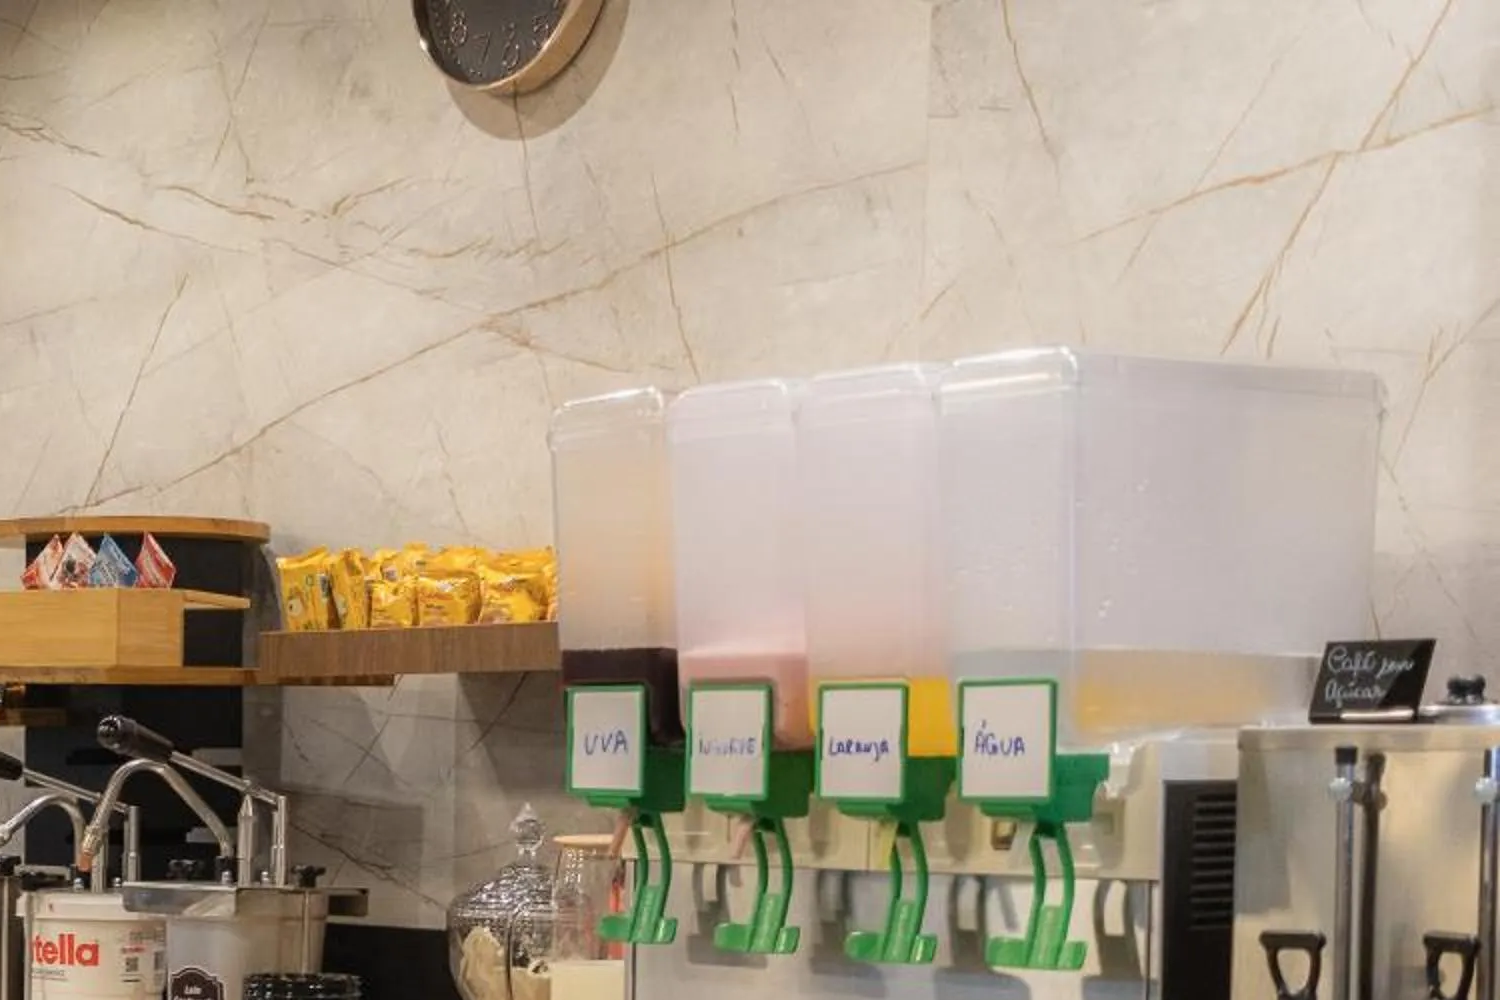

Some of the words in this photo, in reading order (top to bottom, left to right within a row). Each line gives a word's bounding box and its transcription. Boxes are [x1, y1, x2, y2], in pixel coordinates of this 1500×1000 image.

[583, 729, 629, 756] UVA
[974, 718, 1027, 757] ÁGUA
[31, 932, 100, 967] tella
